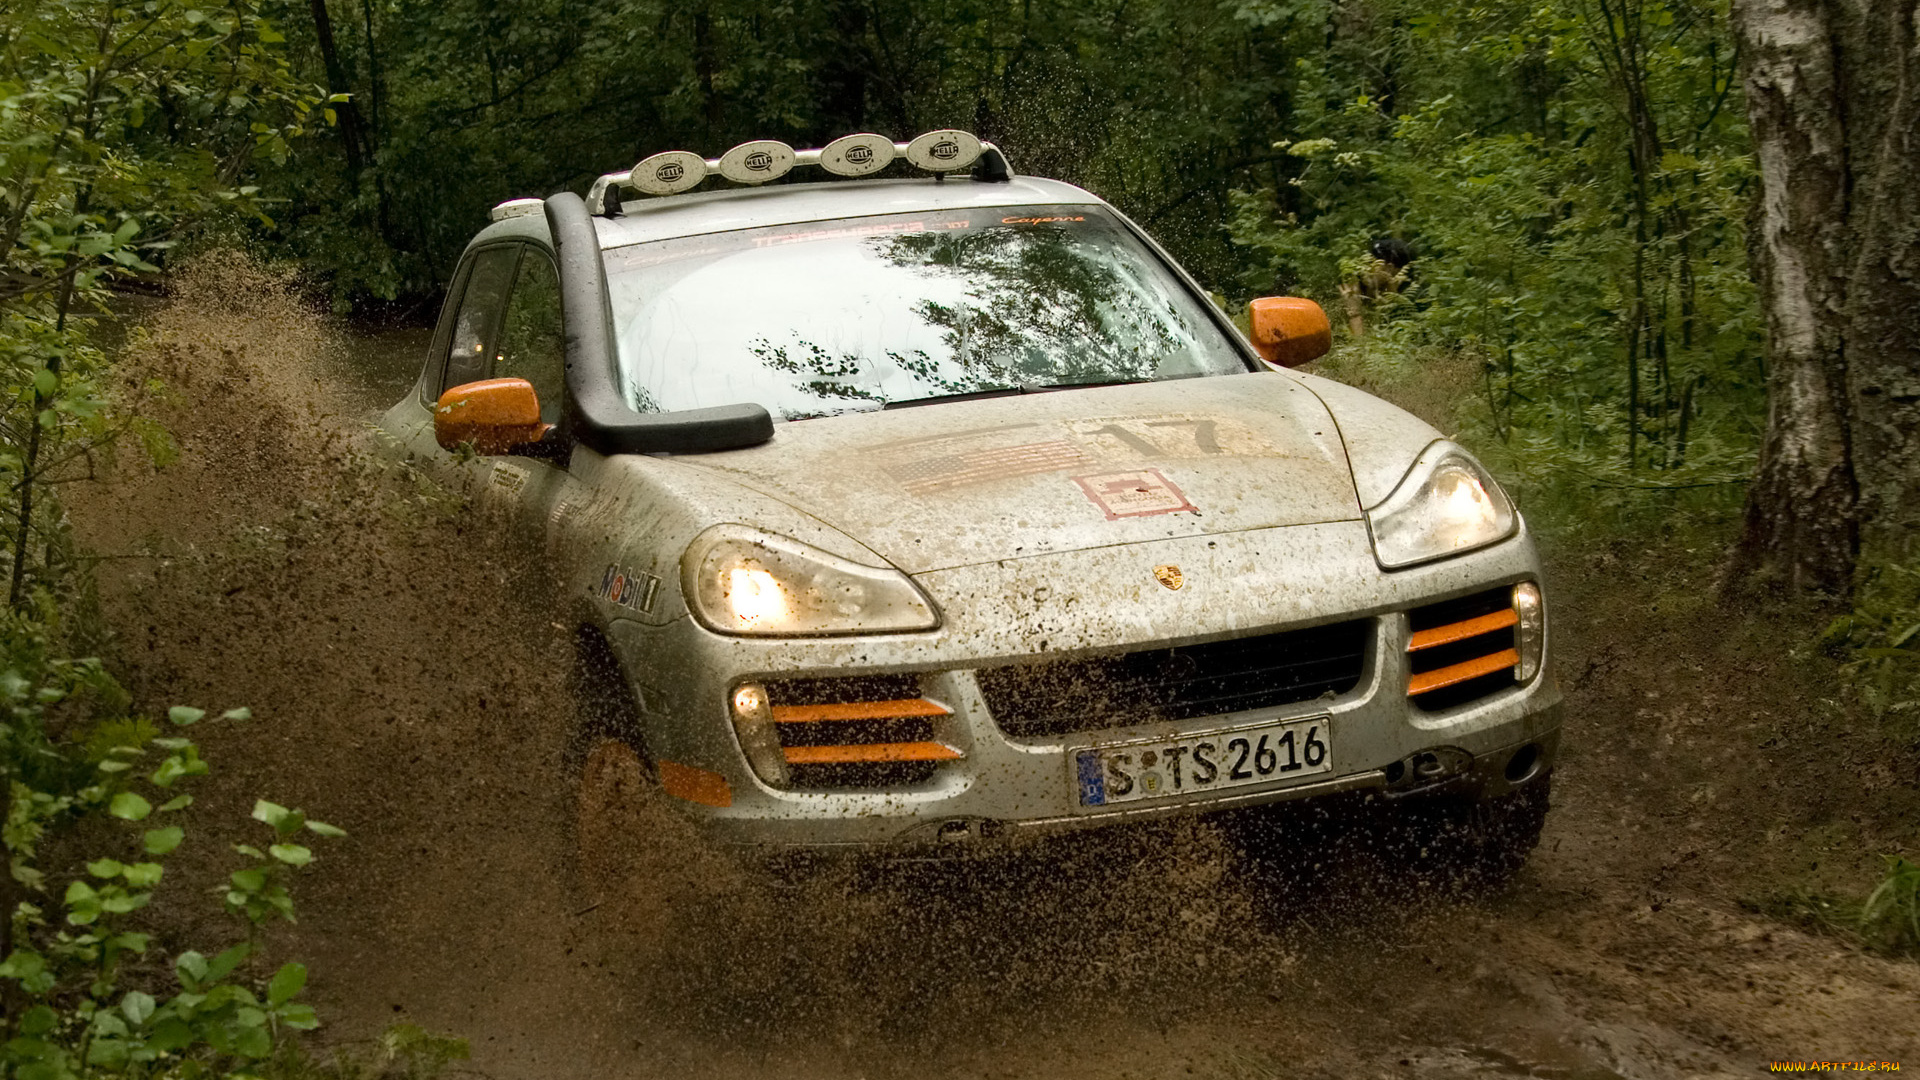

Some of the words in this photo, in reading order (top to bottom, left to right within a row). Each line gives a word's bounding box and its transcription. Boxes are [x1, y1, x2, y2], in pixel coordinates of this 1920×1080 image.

[846, 149, 873, 159] HELLA
[932, 144, 959, 156] HELLA
[746, 155, 772, 167] HELLA
[658, 166, 684, 178] HELLA
[1001, 215, 1086, 226] Cayenne
[597, 562, 647, 610] Mobil
[1107, 752, 1134, 796] S
[1228, 725, 1326, 781] 2616
